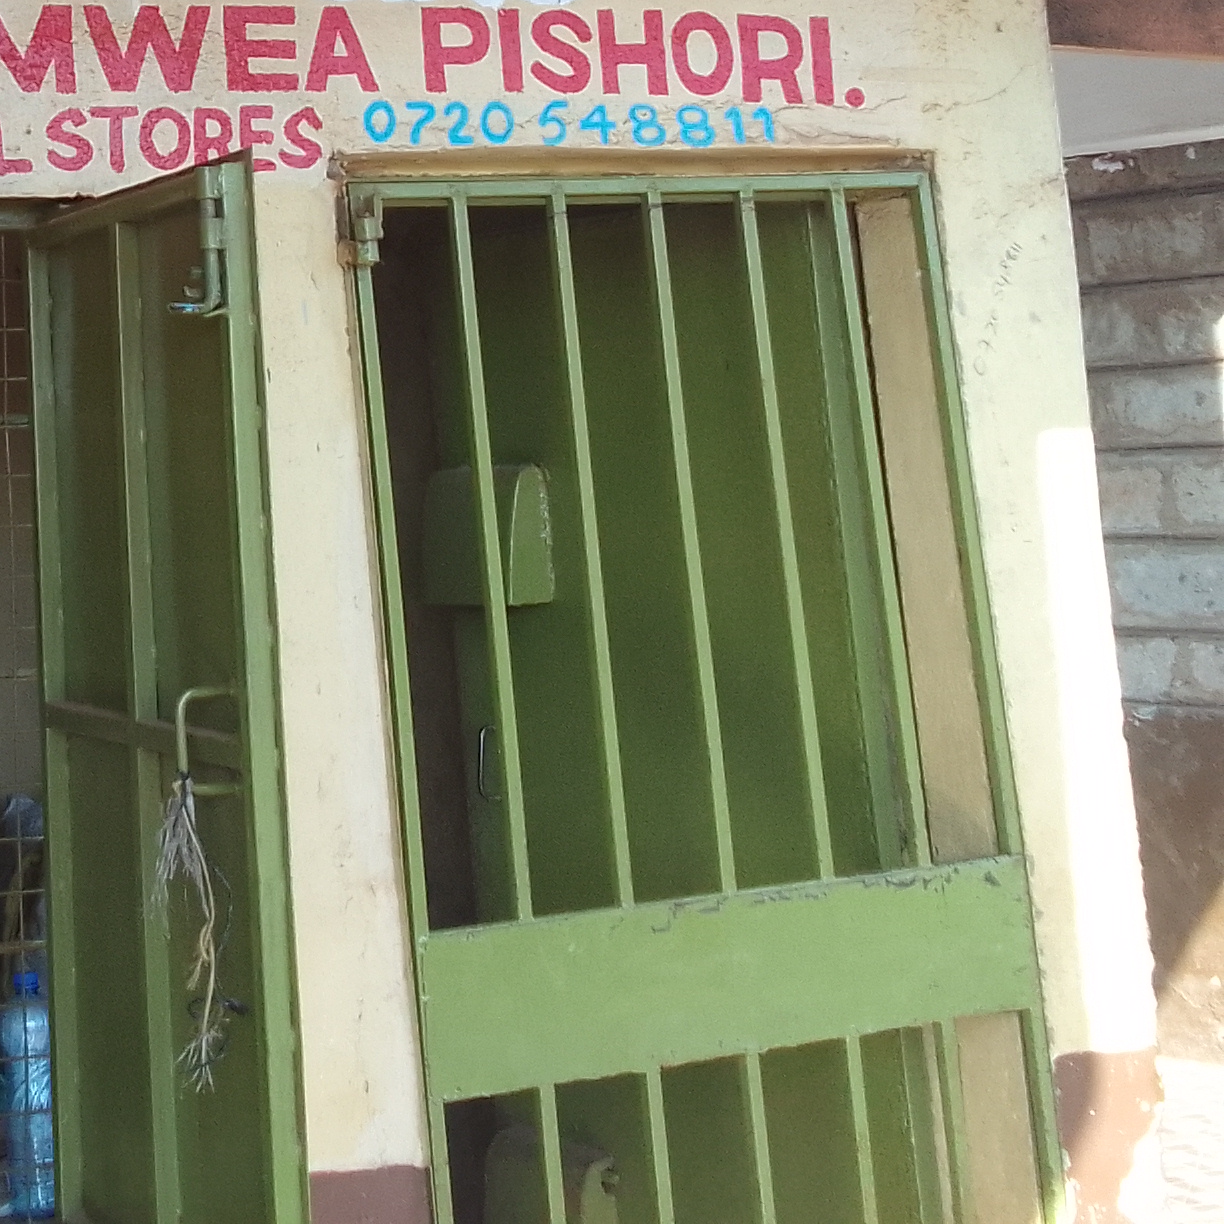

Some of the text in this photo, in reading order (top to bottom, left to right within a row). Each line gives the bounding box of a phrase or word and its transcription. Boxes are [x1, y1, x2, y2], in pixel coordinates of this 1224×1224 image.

[421, 6, 866, 107] PISHORI.
[46, 104, 324, 173] STORES
[363, 99, 776, 148] 0720 548811
